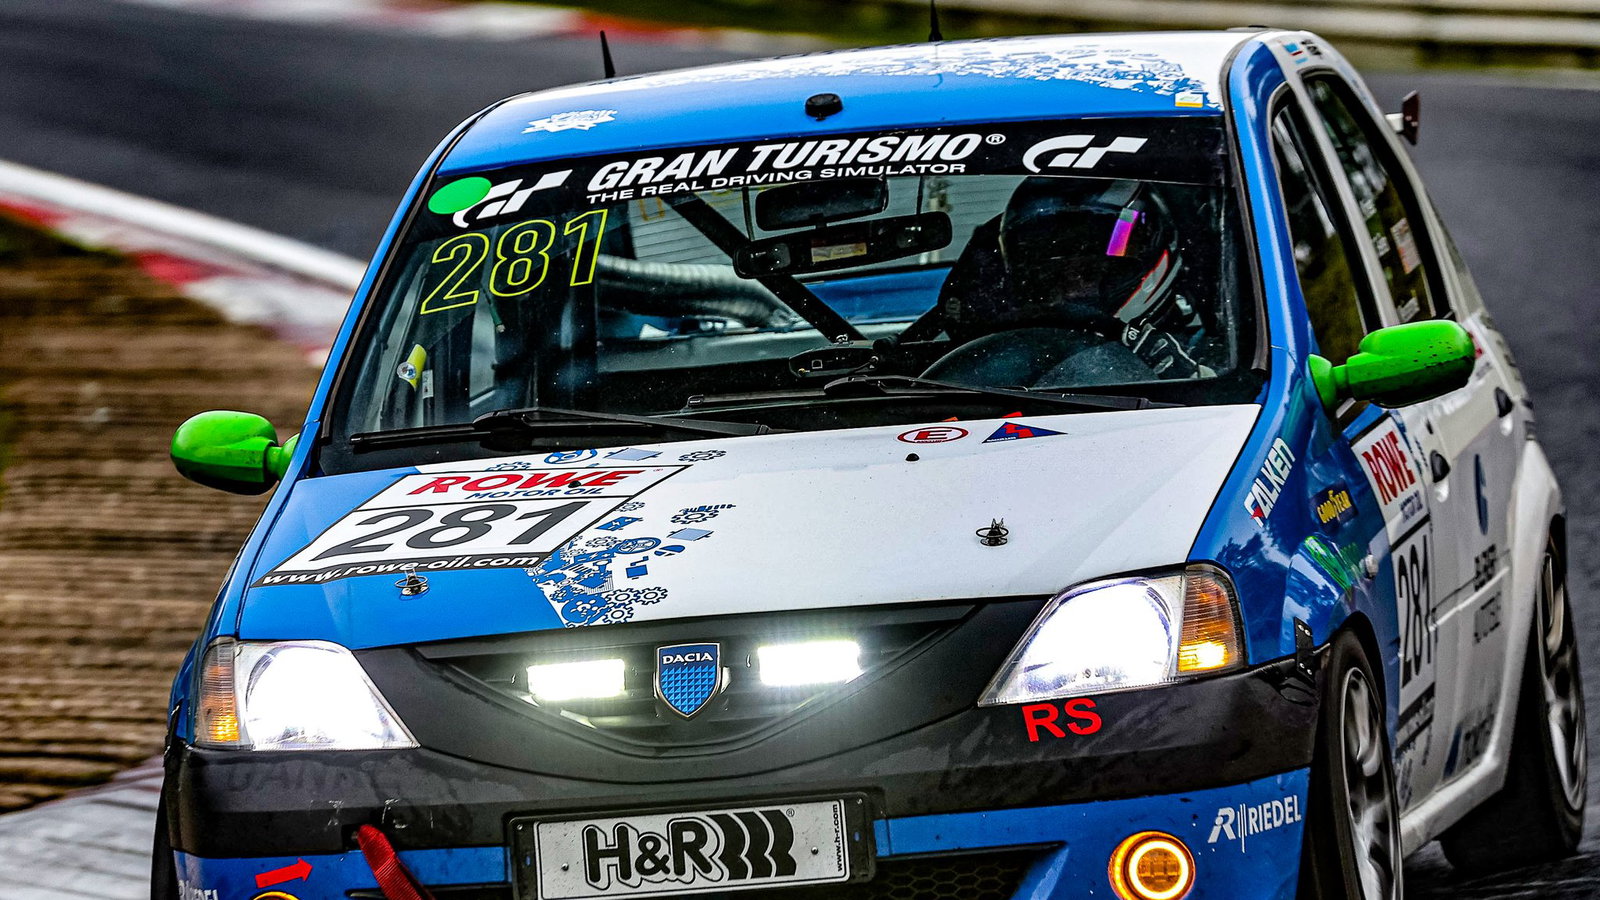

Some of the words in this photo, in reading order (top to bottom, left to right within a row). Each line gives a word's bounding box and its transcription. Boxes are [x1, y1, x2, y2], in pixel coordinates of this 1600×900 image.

[586, 188, 634, 204] THE
[641, 180, 705, 197] REAL
[711, 170, 813, 188] DRIVING
[819, 162, 967, 179] SIMULATOR
[587, 147, 740, 192] GRAN
[420, 208, 609, 315] 281
[406, 469, 646, 496] ROWE
[1243, 437, 1296, 528] FALKEN
[1361, 430, 1416, 506] ROWE
[464, 489, 561, 501] MOTOR
[564, 487, 604, 496] OIL
[308, 500, 592, 562] 281
[262, 554, 541, 585] www.rowe-oil.com
[1398, 534, 1432, 689] 281
[662, 652, 714, 665] DACIA
[1021, 697, 1102, 742] RS
[832, 804, 843, 872] www.h-r.com
[1249, 795, 1302, 838] RIEDEL
[583, 817, 723, 889] H&R
